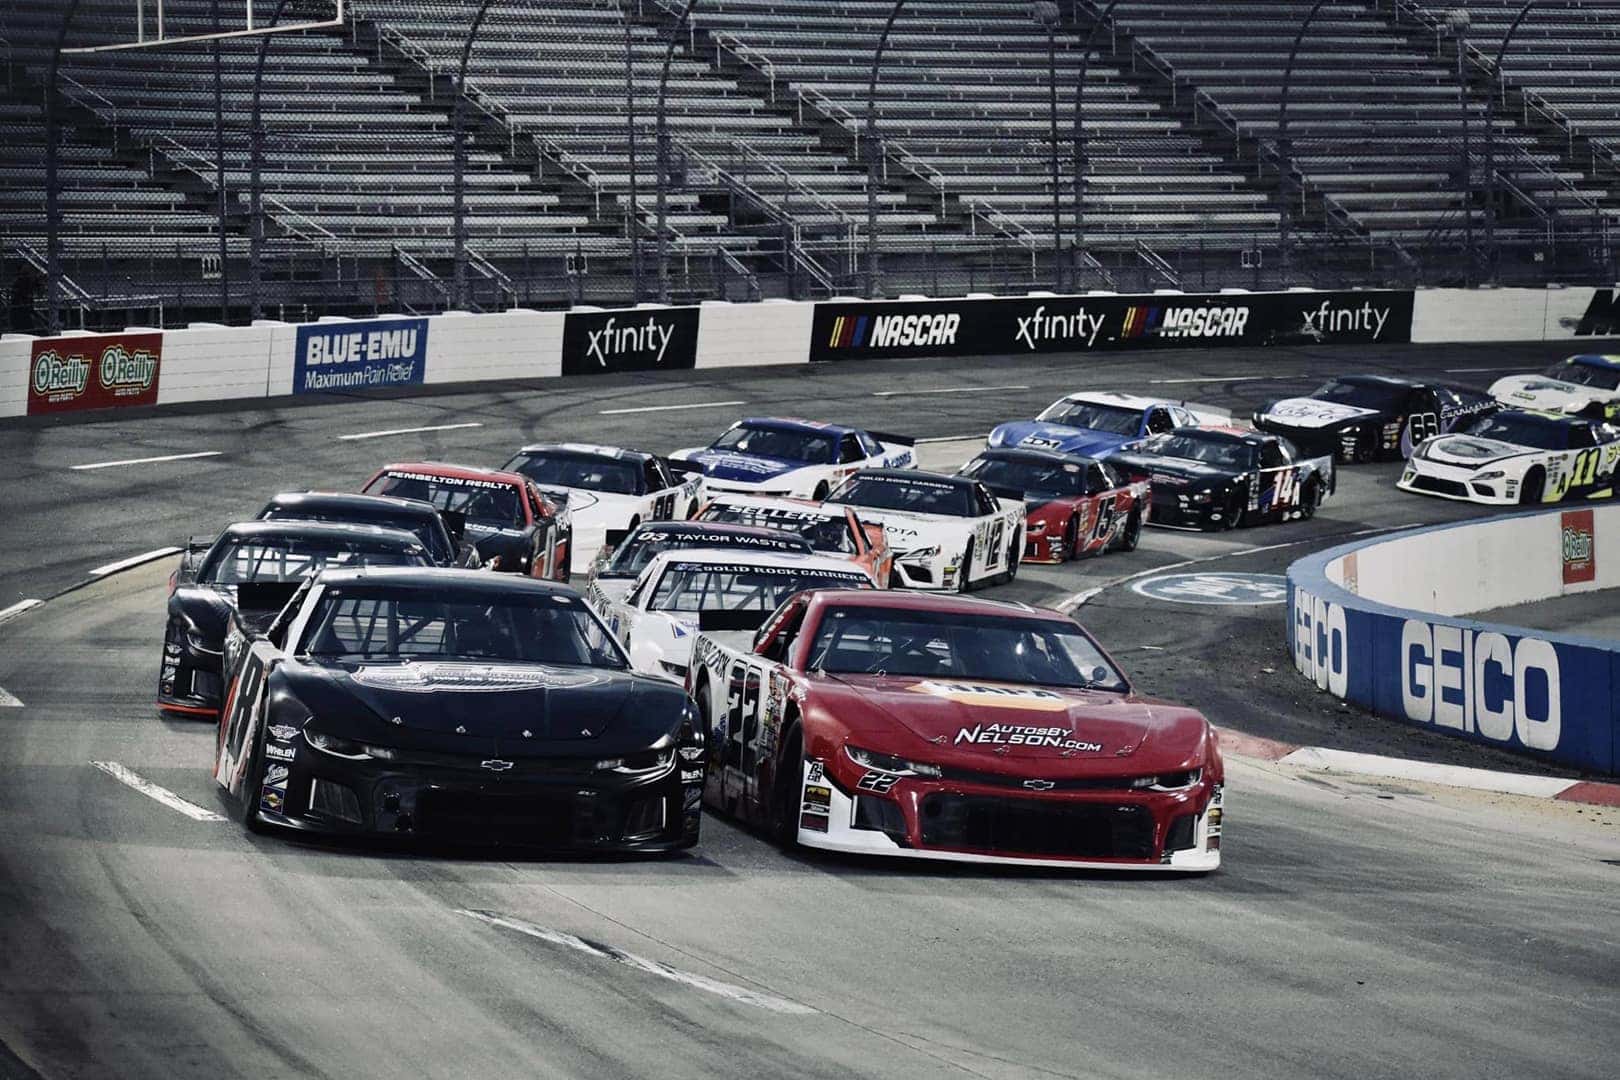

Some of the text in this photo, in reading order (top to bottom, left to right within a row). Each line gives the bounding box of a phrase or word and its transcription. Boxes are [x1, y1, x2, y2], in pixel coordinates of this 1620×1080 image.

[870, 313, 961, 347] NASCAR
[1015, 306, 1105, 349] xfinity
[1160, 307, 1249, 337] NASCAR
[1302, 300, 1391, 342] xfinity
[306, 329, 417, 366] BLUE-EMU
[586, 317, 675, 367] xfinity
[34, 352, 90, 393] O'Reilly
[101, 346, 156, 388] O'Reilly
[305, 369, 362, 389] Maximum
[388, 471, 464, 486] PEMBELTON
[1570, 448, 1601, 487] 11
[726, 505, 832, 523] SELLERS
[886, 526, 918, 536] OTA
[676, 533, 730, 543] TAYLOR
[735, 536, 788, 549] WASTE
[703, 565, 749, 573] SOLID
[754, 567, 798, 576] ROCK
[799, 569, 868, 583] CARRIERS
[1402, 619, 1561, 752] GEICO
[856, 770, 901, 793] 22
